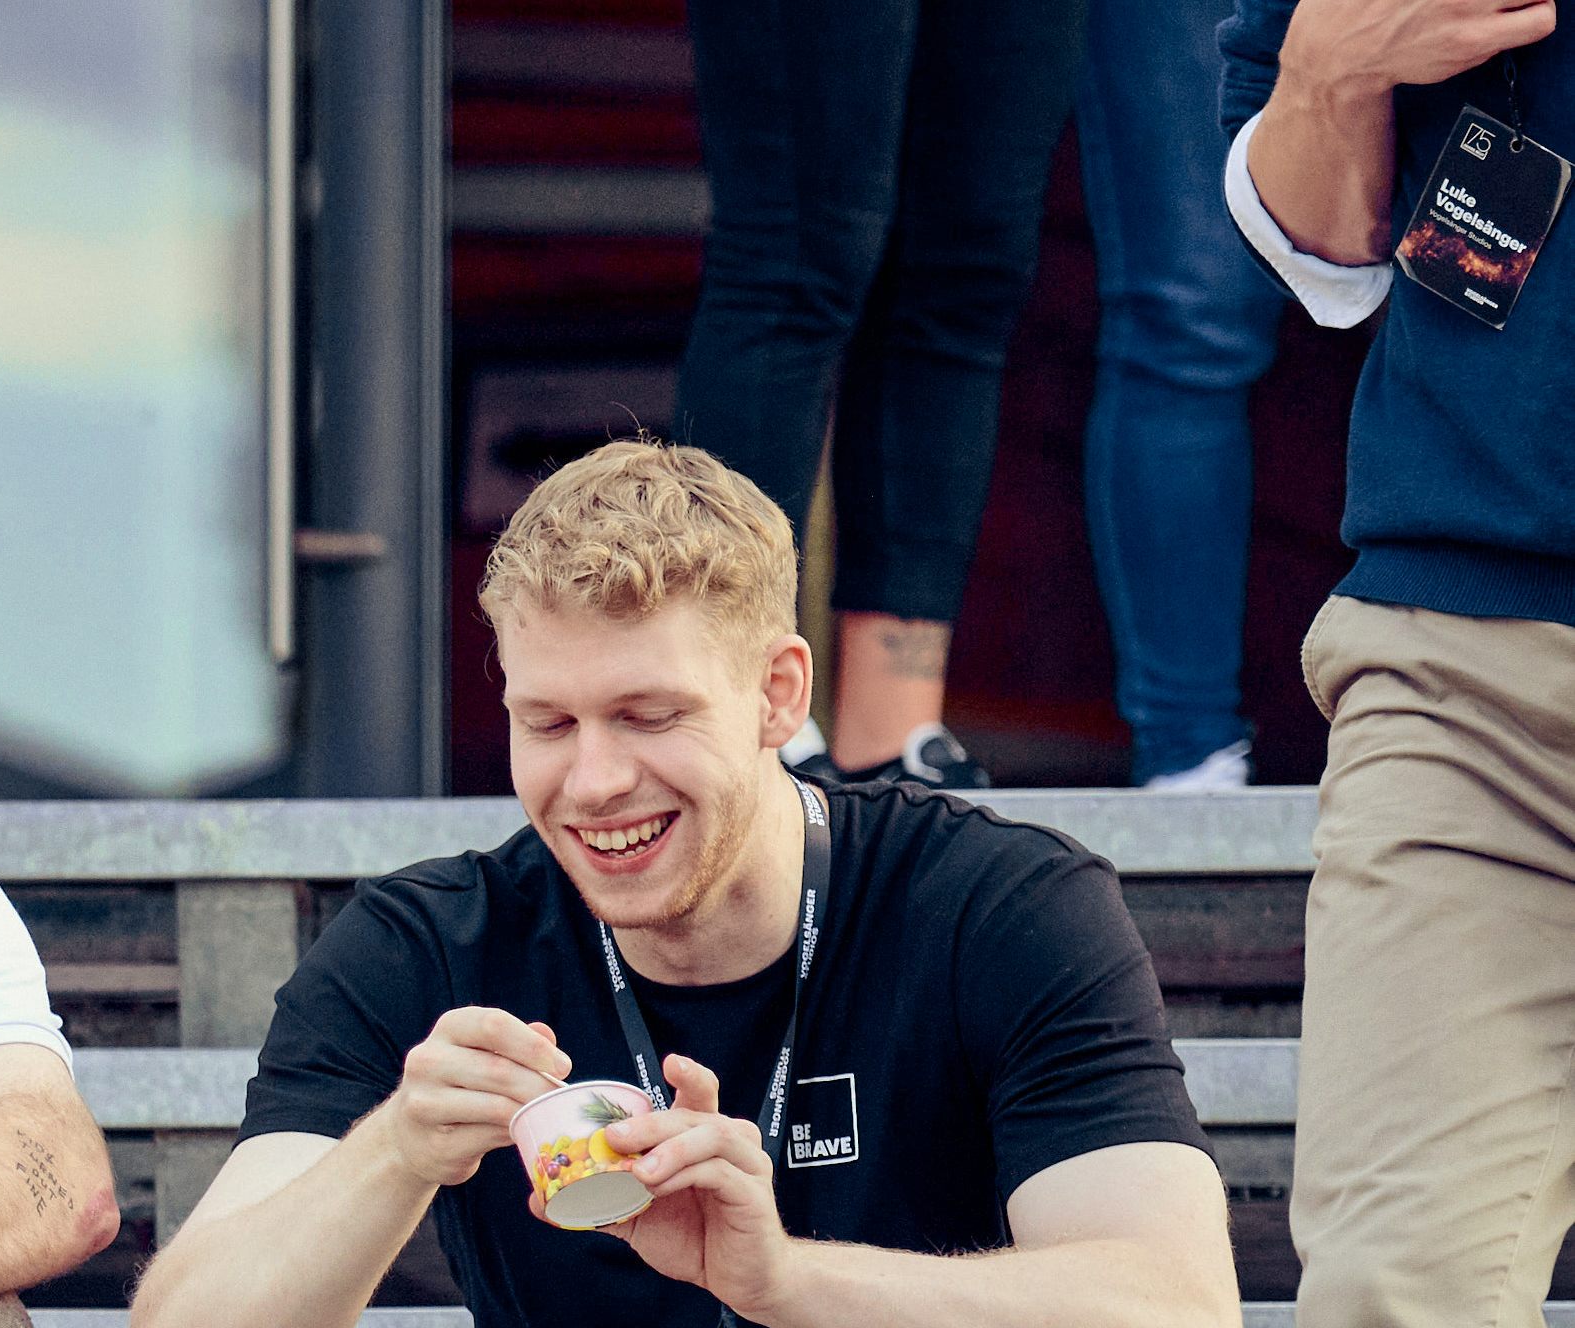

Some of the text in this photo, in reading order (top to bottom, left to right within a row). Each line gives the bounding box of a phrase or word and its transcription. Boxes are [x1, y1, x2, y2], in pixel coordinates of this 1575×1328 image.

[1463, 123, 1496, 153] 75
[1440, 178, 1476, 207] Luke
[1429, 209, 1492, 250] Vogelsänger Studios
[1435, 192, 1527, 253] Vogelsänger
[791, 1123, 811, 1141] BE
[793, 1136, 853, 1159] BRAVE
